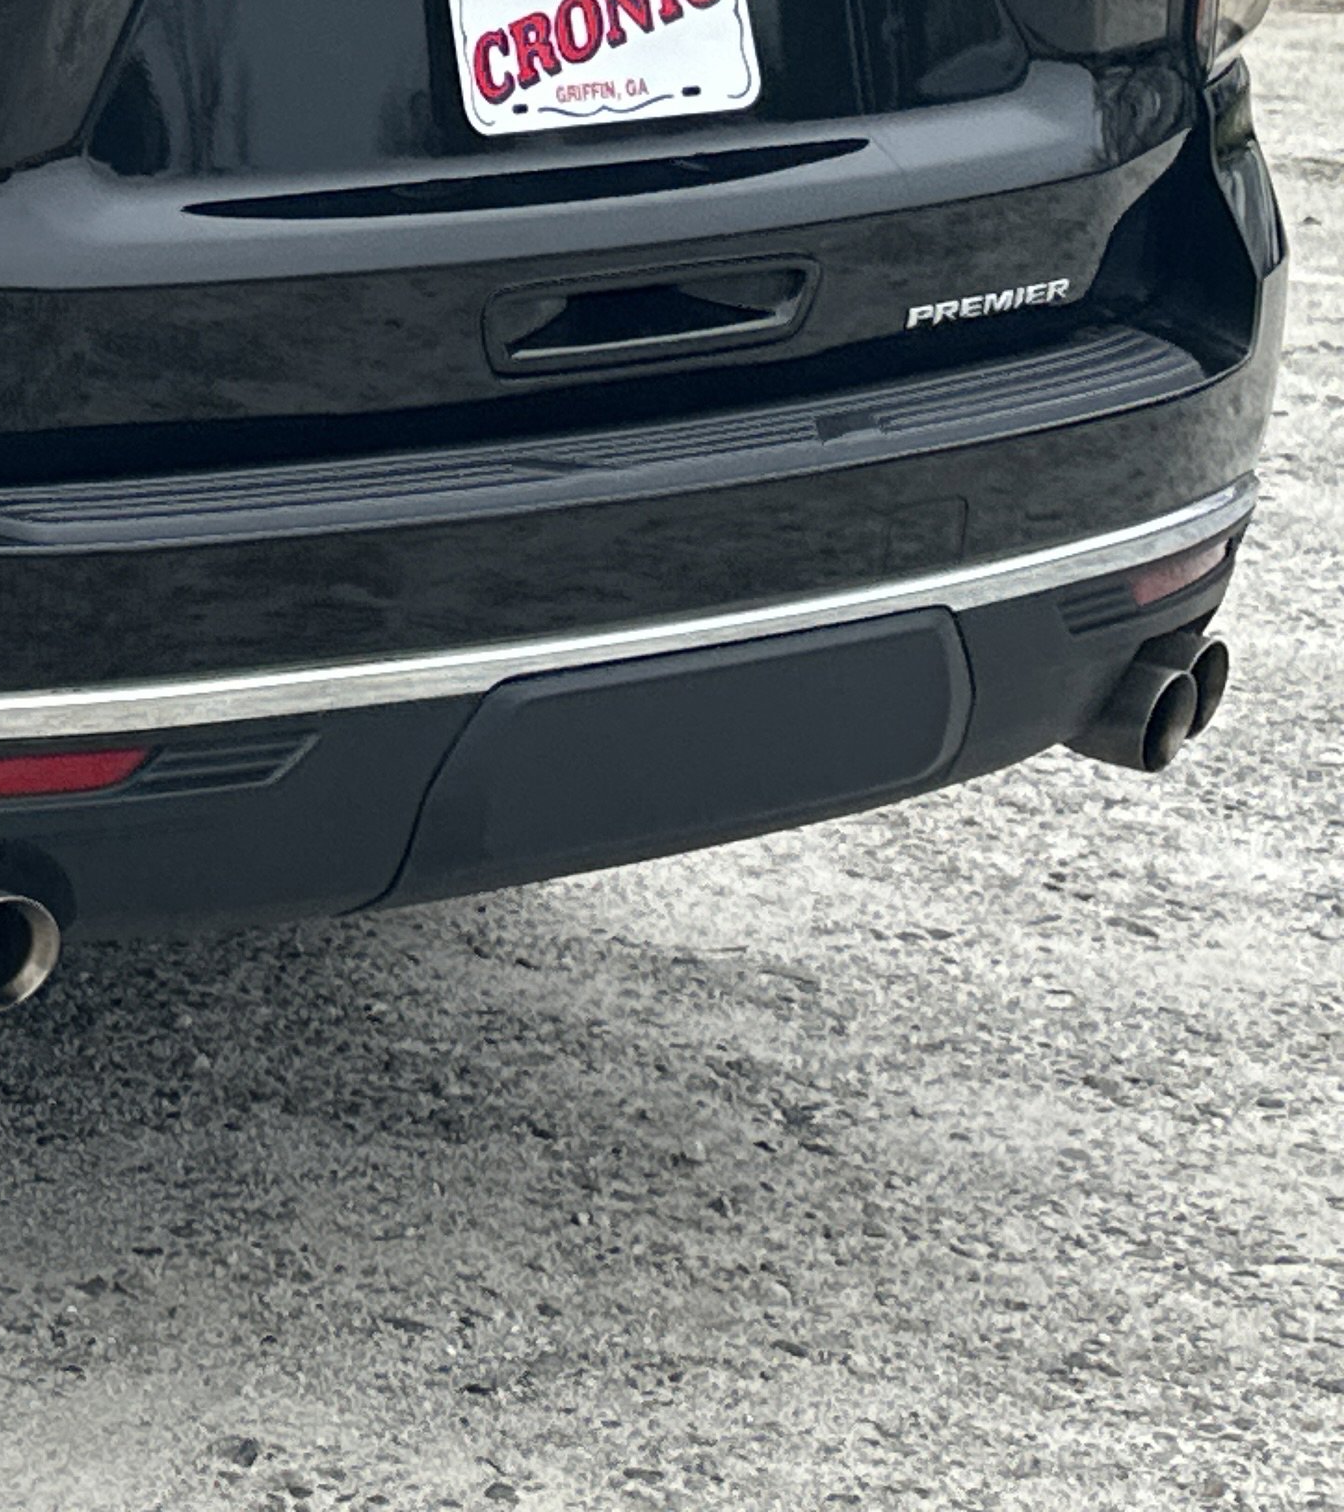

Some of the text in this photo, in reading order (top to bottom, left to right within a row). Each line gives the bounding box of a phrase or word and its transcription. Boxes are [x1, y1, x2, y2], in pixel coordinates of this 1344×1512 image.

[555, 77, 650, 104] GRIFFIN, GA
[905, 278, 1070, 330] PREMIER
